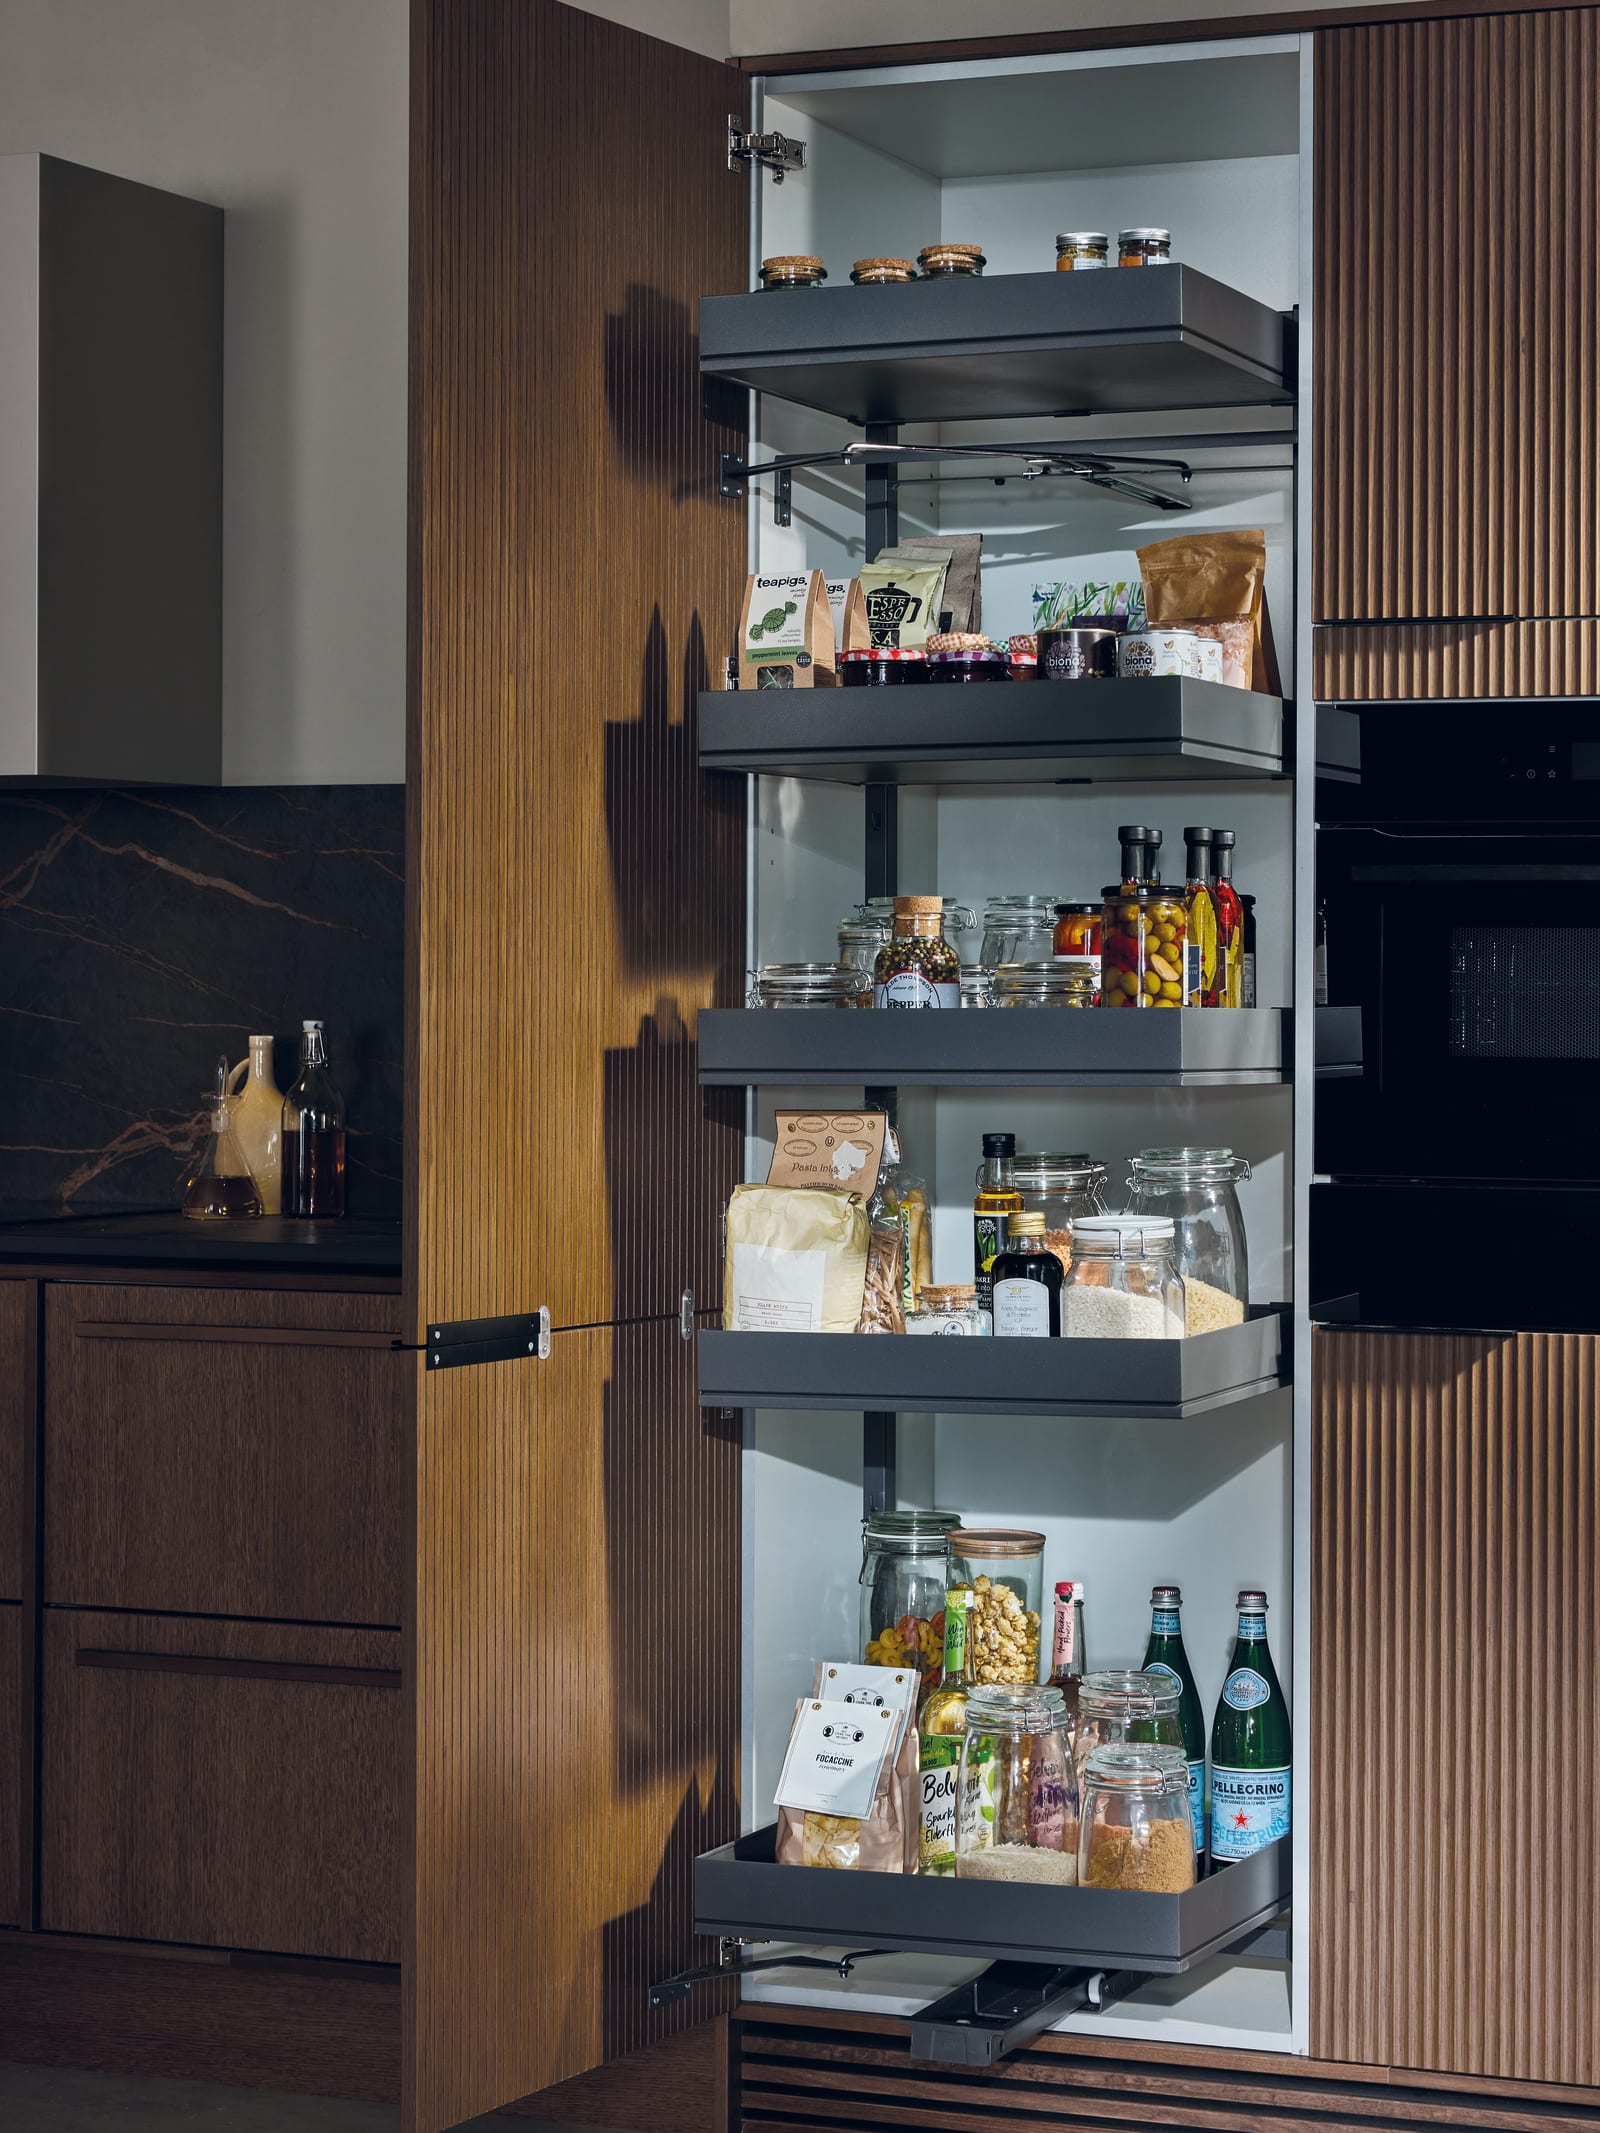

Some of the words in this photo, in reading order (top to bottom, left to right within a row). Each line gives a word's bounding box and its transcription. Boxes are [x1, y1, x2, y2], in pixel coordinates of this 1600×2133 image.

[1049, 657, 1080, 666] biona
[1125, 655, 1152, 665] biona
[791, 1163, 817, 1172] Pasta
[815, 1753, 854, 1767] FOCACCINE
